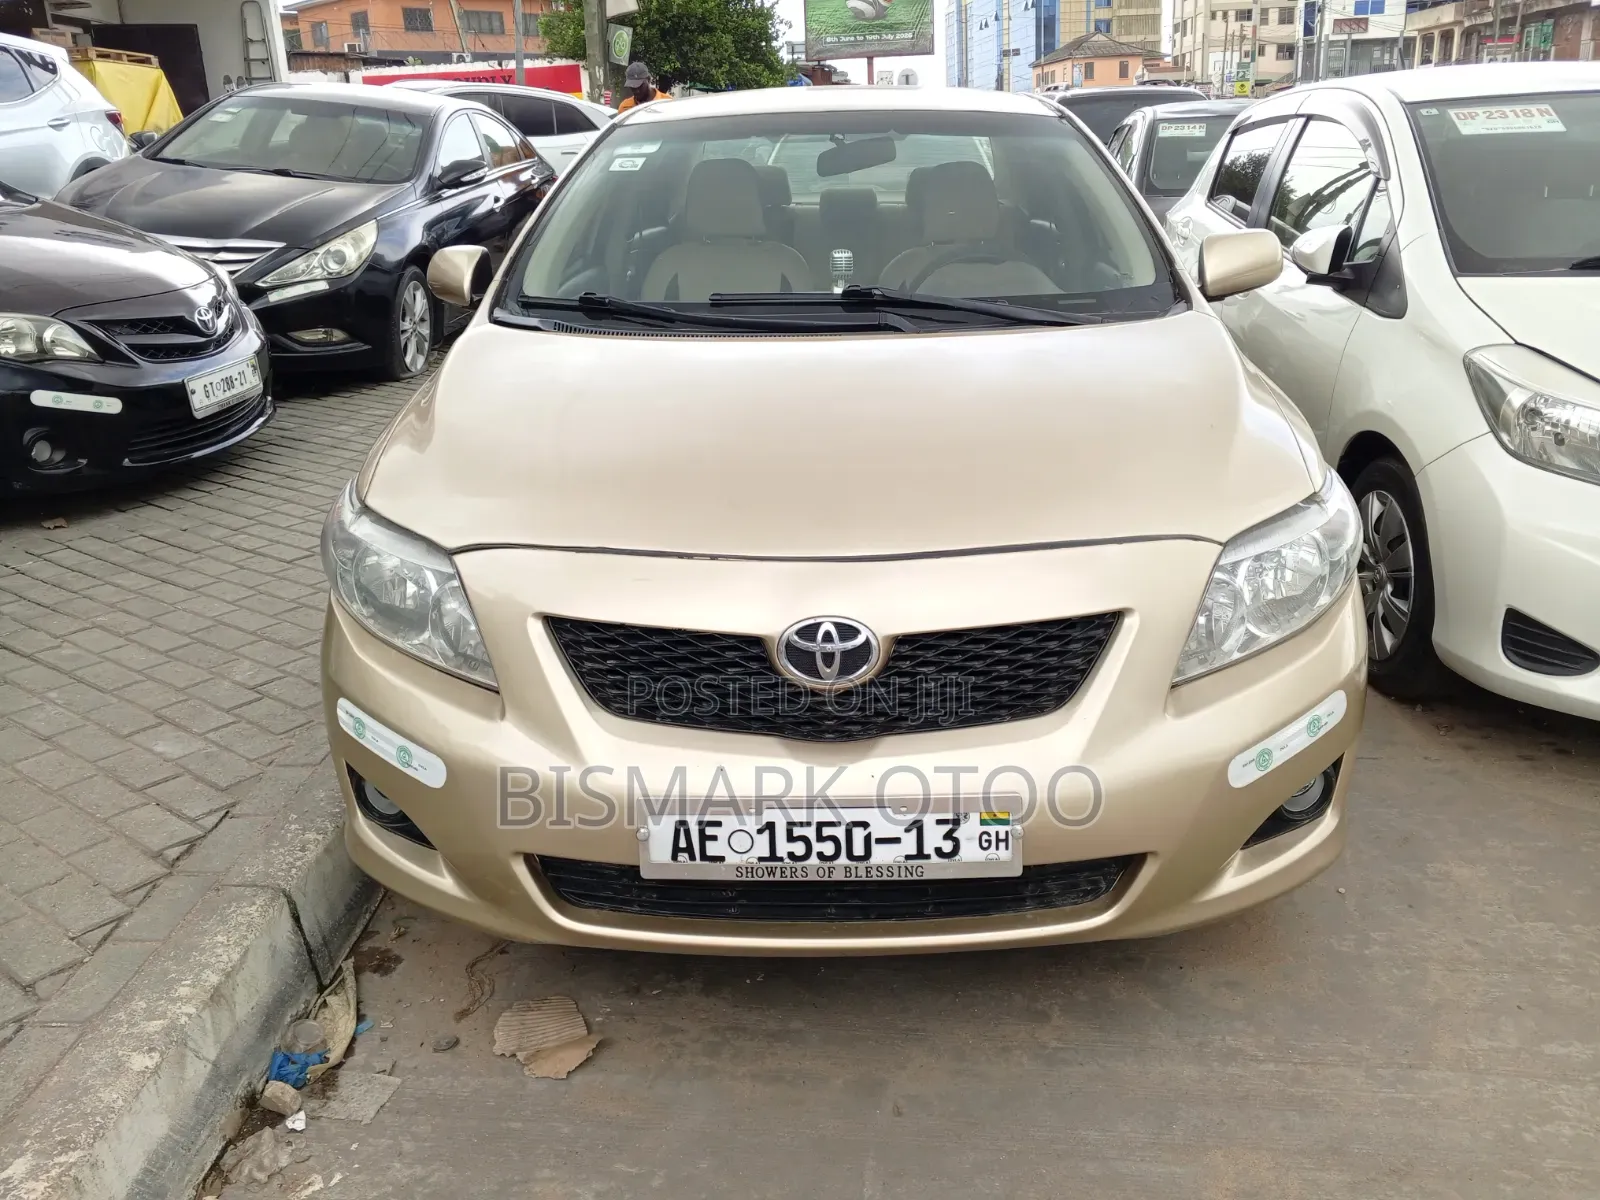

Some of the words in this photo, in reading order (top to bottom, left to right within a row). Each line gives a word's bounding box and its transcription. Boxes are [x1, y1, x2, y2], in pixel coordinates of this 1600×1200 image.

[1454, 111, 1480, 121] DP
[1482, 108, 1534, 120] 2318
[1539, 107, 1554, 117] N
[203, 382, 215, 398] GT
[671, 820, 726, 862] AE
[757, 819, 961, 862] 1550-13
[978, 831, 1010, 851] GH
[735, 865, 809, 880] SHOWERS
[816, 866, 836, 879] OF
[844, 864, 925, 879] BLESSING
